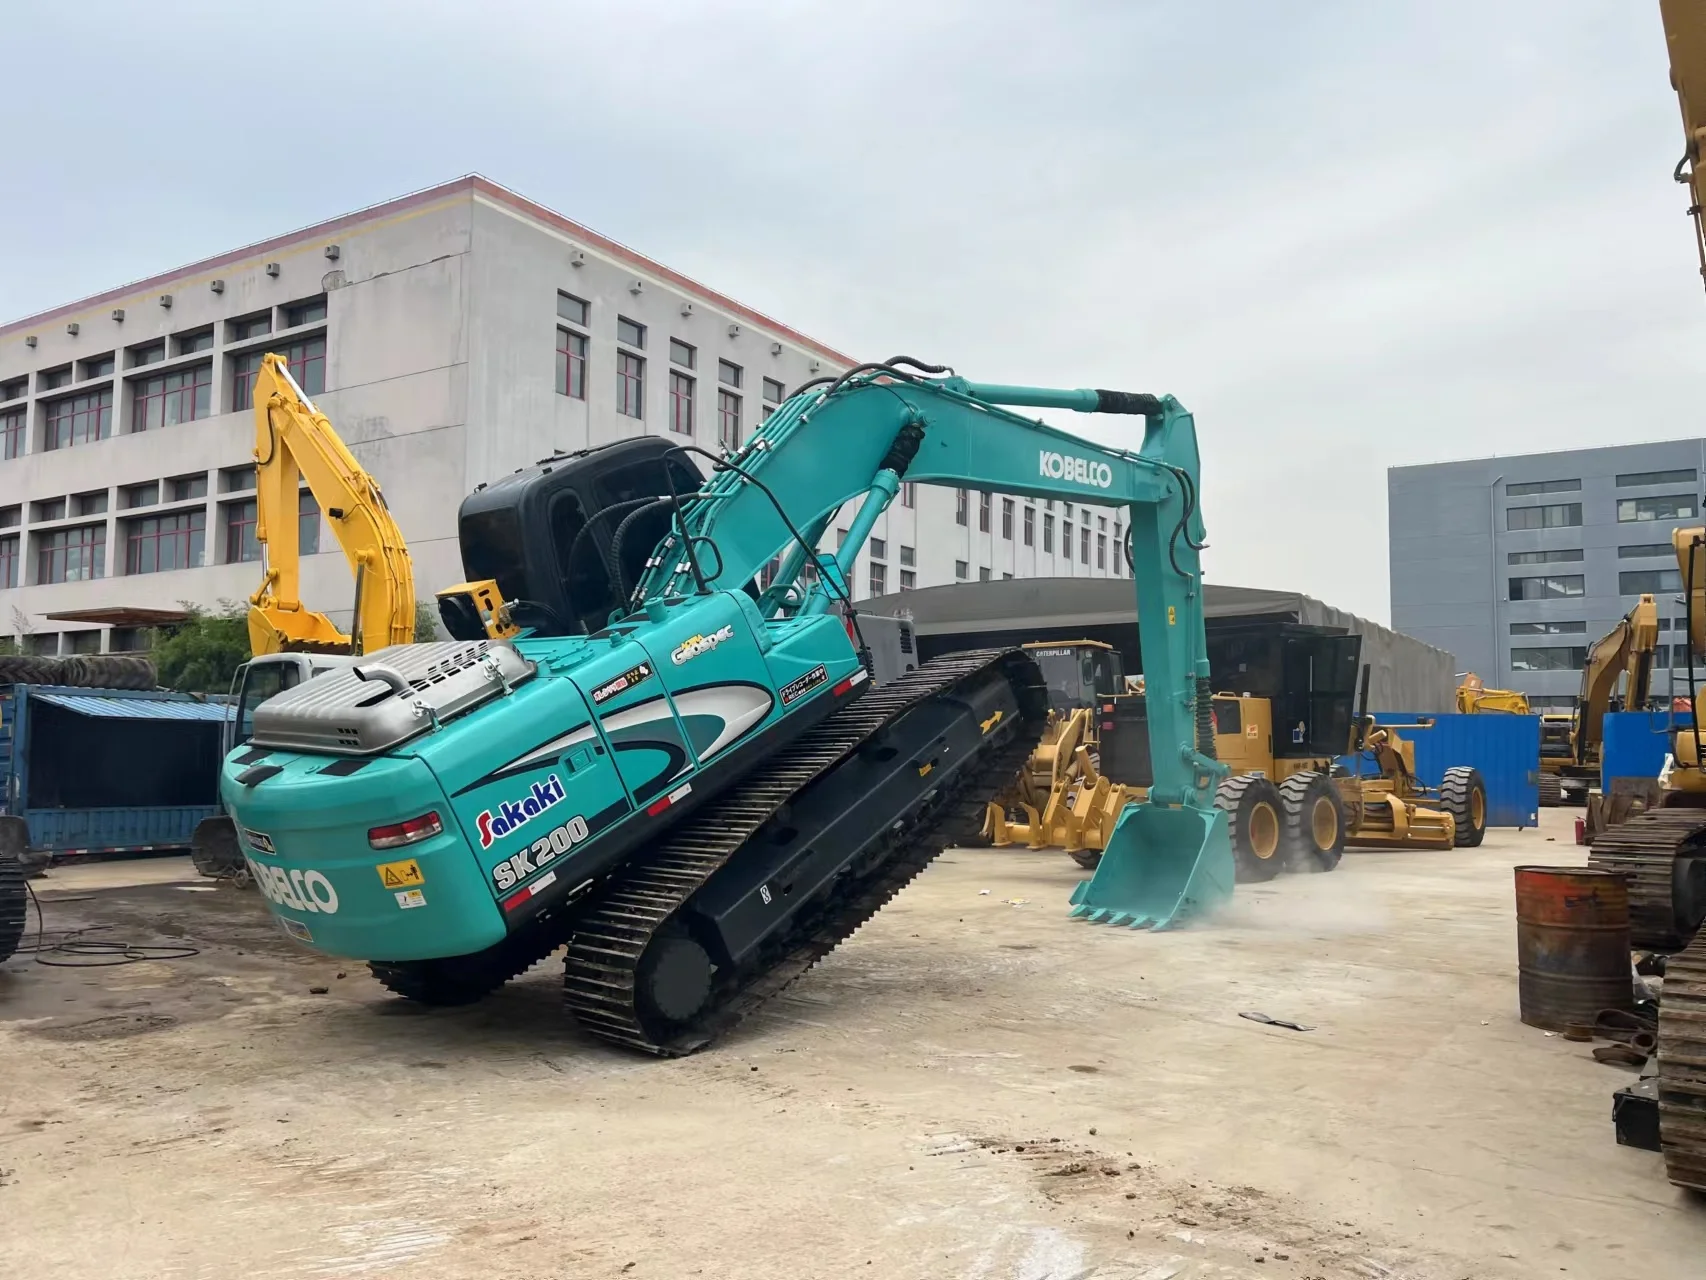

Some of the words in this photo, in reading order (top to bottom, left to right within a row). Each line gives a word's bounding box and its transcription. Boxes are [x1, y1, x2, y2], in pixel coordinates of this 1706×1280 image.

[1039, 450, 1112, 488] KOBELCO
[1036, 649, 1071, 657] CATERPILLAR
[476, 774, 567, 850] Sakaki
[493, 815, 589, 890] SK200
[246, 858, 339, 914] OBELCO
